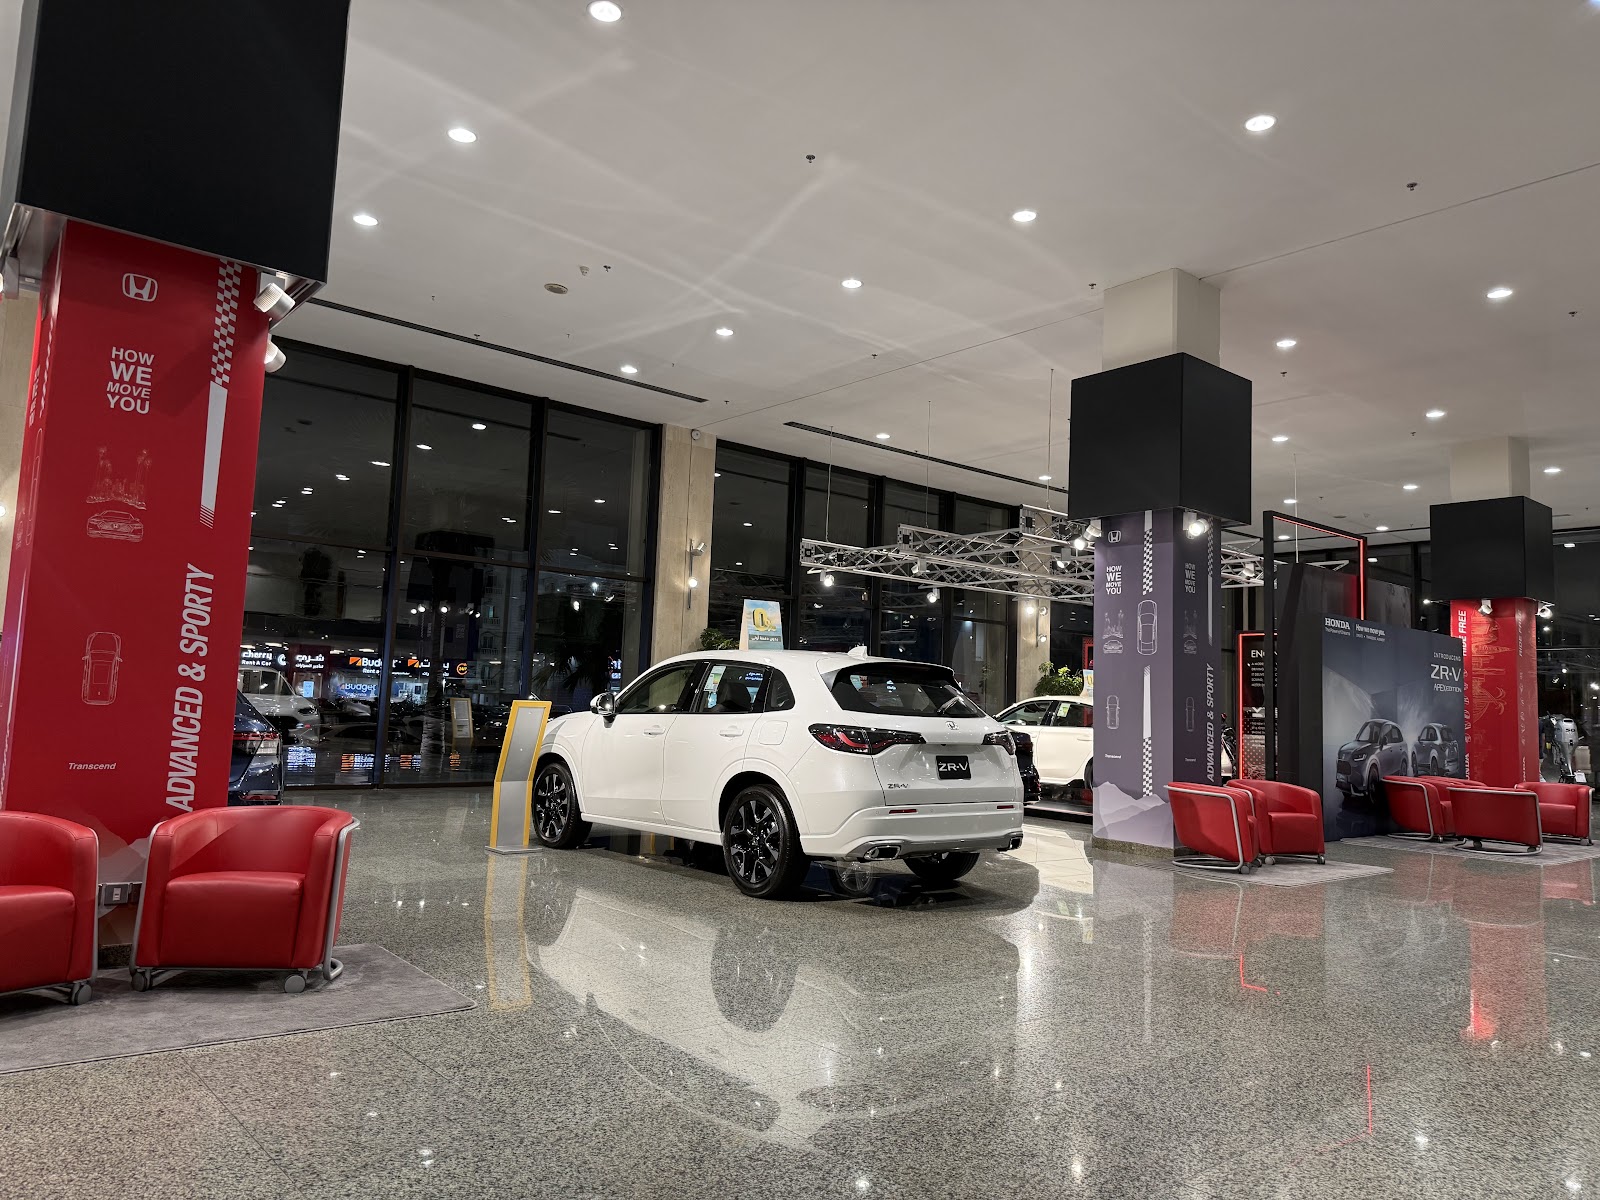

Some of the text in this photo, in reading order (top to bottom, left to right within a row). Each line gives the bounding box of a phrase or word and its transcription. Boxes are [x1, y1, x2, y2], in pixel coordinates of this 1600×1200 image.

[111, 346, 154, 366] HOW
[109, 360, 153, 386] WE
[106, 381, 151, 399] MOVE
[106, 394, 150, 415] YOU
[1106, 572, 1122, 582] WE
[1184, 569, 1196, 580] WE
[1105, 587, 1122, 595] YOU
[1184, 585, 1196, 594] YOU
[1324, 618, 1350, 630] HONDA
[1458, 609, 1467, 634] FREE
[241, 650, 273, 661] cherry
[166, 562, 215, 812] ADVANCED & SPORTY
[1206, 662, 1215, 708] SPORTY
[1205, 722, 1215, 783] ADVANCED
[67, 762, 117, 770] Transcend
